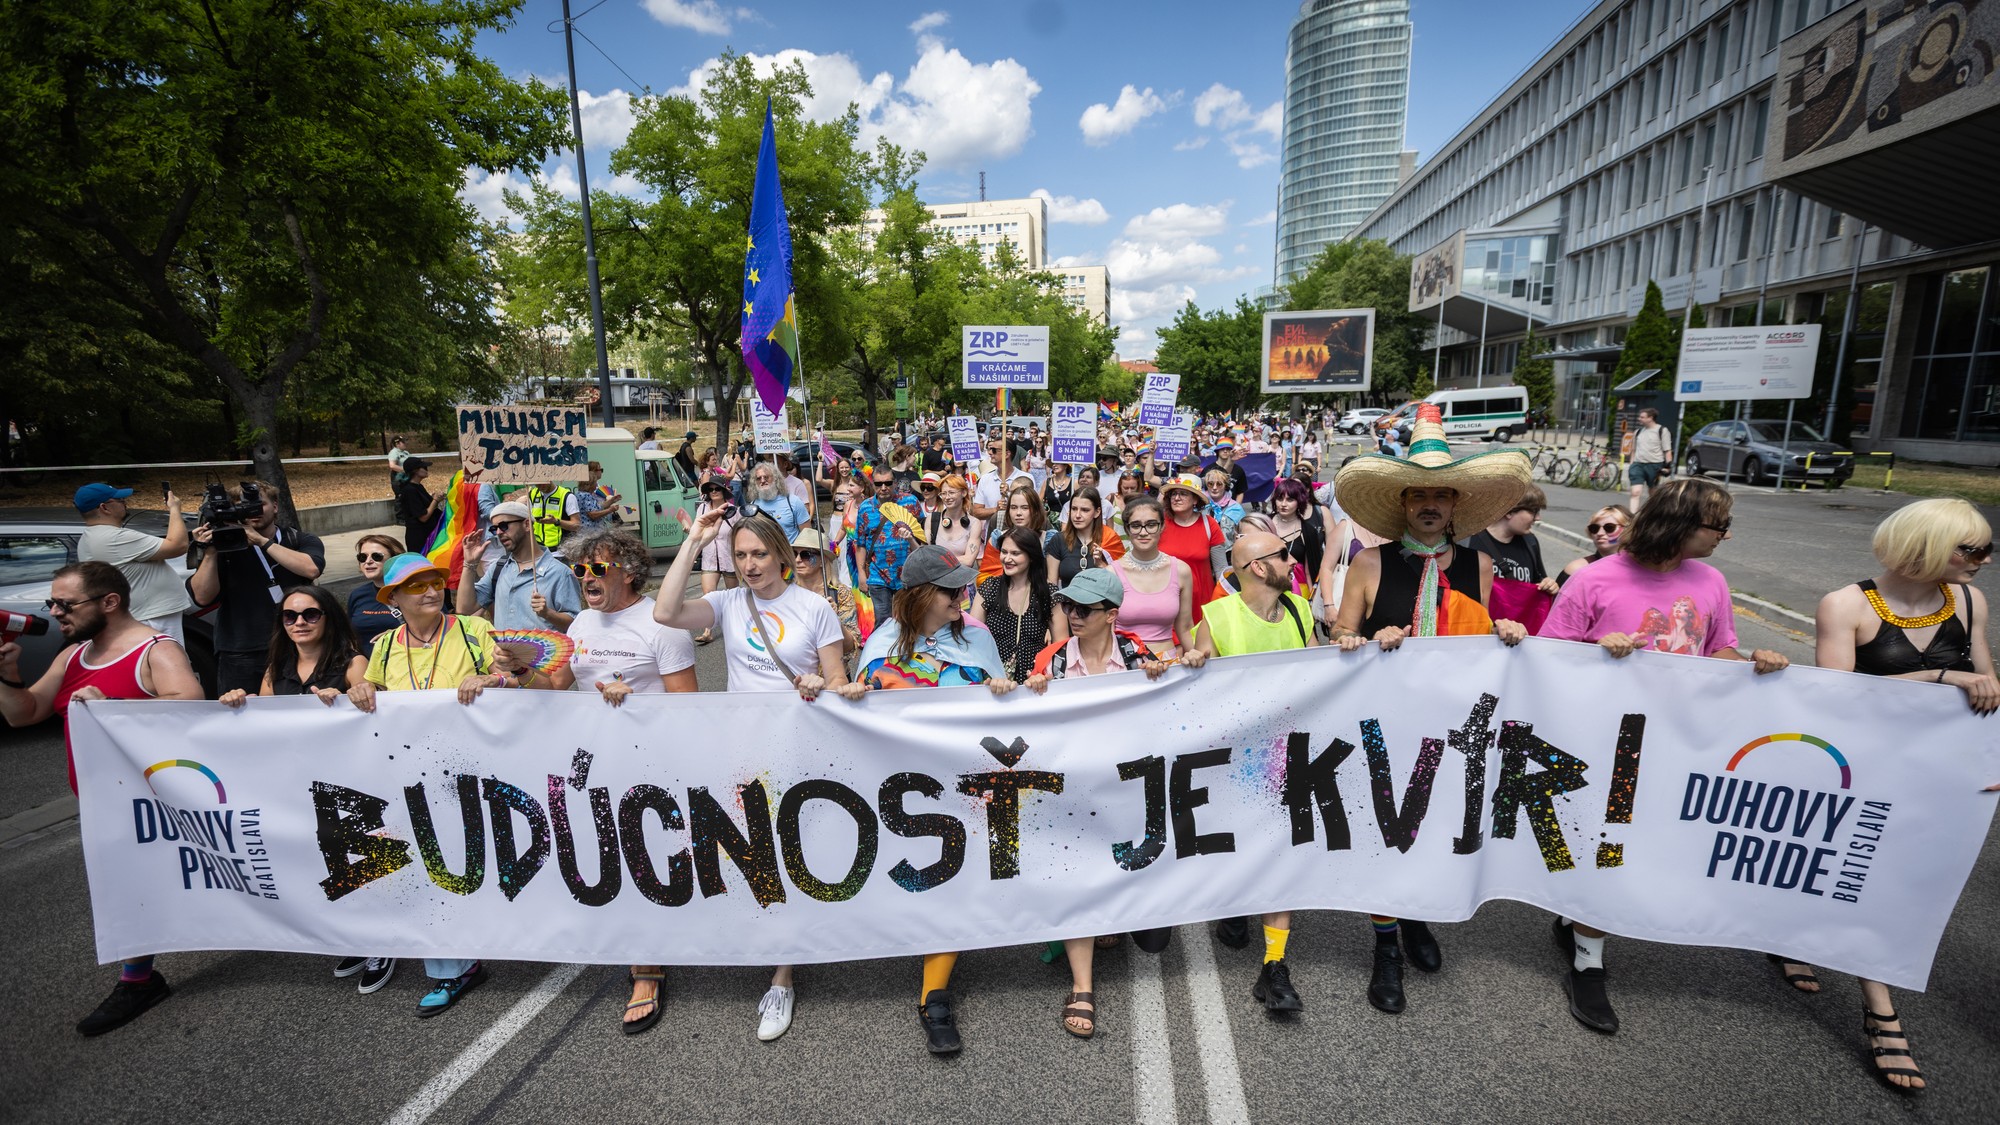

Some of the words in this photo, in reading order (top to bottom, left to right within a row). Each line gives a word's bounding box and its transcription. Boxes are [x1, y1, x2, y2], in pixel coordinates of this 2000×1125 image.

[1284, 324, 1307, 336] EVIL
[1766, 331, 1805, 339] ACCORD
[969, 331, 1009, 348] ZRP
[1276, 335, 1305, 347] DEAD
[982, 363, 1027, 372] KRÁČAME
[970, 374, 976, 382] S
[979, 372, 1010, 382] NAŠIMI
[1014, 373, 1042, 382] DEŤMI
[1149, 376, 1171, 387] ZRP
[1057, 405, 1086, 418] ZRP
[1144, 405, 1171, 413] KRÁČAME
[460, 409, 587, 438] MILUJEM
[951, 418, 969, 428] ZRP
[1056, 439, 1092, 447] KRÁČAME
[1157, 442, 1187, 450] KRÁČAME
[1064, 446, 1089, 454] NAŠIMI
[653, 523, 679, 531] NANUKY
[653, 529, 679, 537] DORUKY
[591, 648, 636, 658] GayChristians
[309, 736, 1064, 909] BUDÚCNOSŤ
[1111, 747, 1236, 872] JE
[1281, 691, 1646, 874] KVÍR!
[1679, 772, 1856, 843] DUHOVY
[132, 798, 237, 853] DUHOVY
[240, 808, 280, 900] BRATISLAVA
[1831, 800, 1892, 904] BRATISLAVA
[1706, 831, 1838, 897] PRIDE
[178, 846, 261, 897] PRIDE
